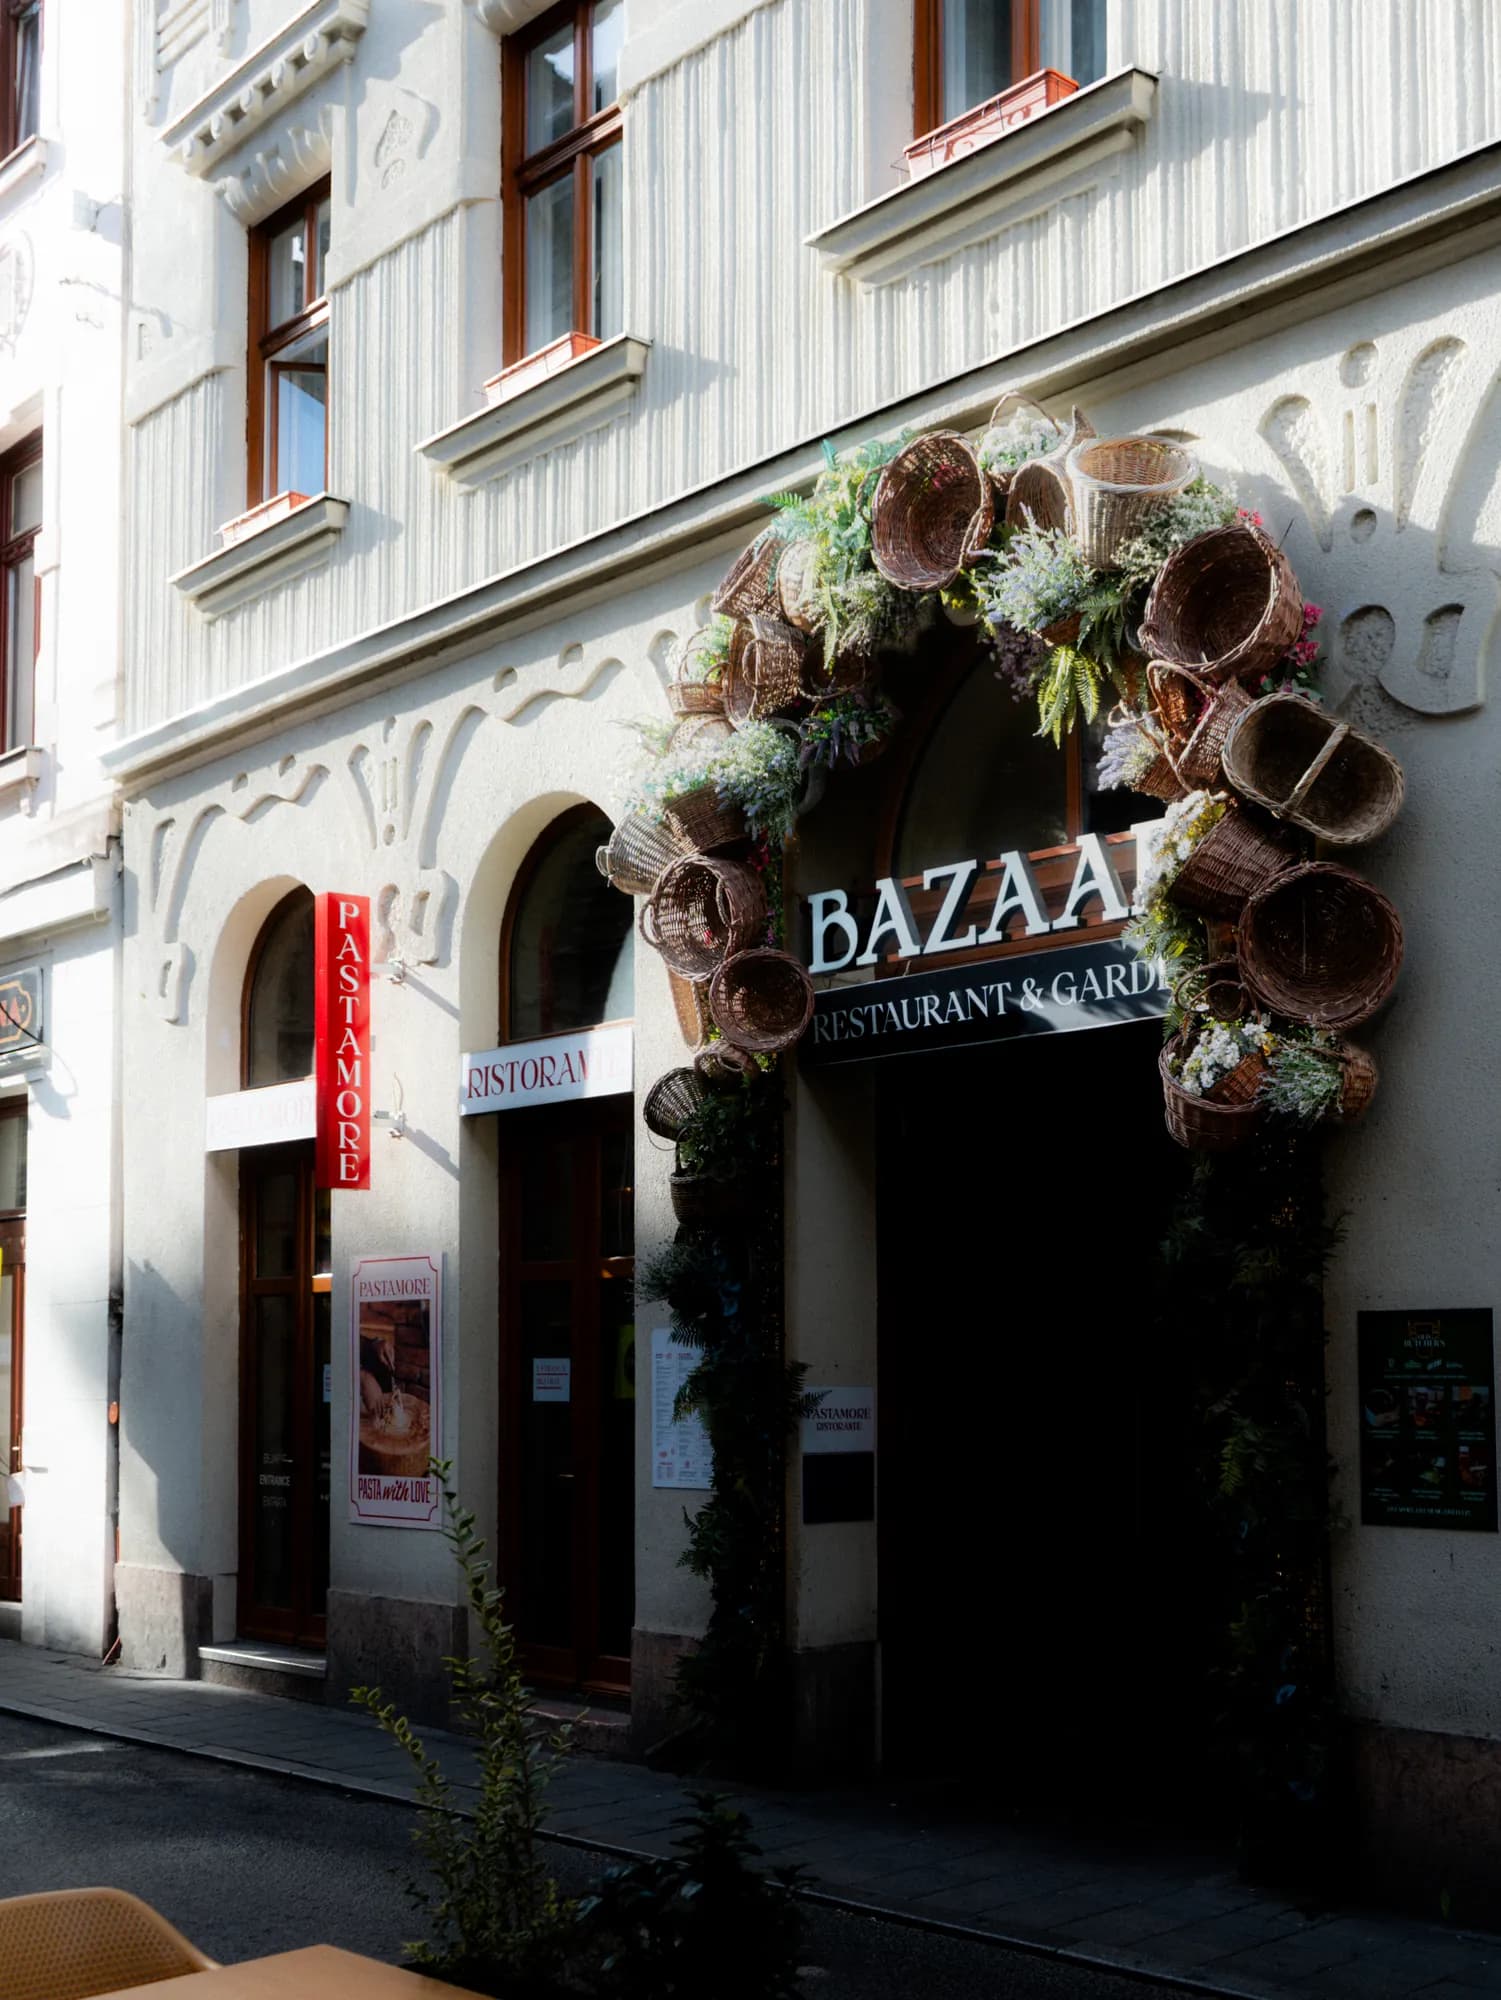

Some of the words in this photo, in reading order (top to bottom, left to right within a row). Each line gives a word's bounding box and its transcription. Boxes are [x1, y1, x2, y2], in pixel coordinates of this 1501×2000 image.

[813, 982, 1014, 1044] RESTAURANT
[1019, 976, 1044, 1012] &
[336, 901, 362, 1181] PASTAMORE
[467, 1049, 618, 1099] RISTORAN
[359, 1278, 431, 1297] PASTAMORE
[806, 1407, 872, 1420] PASTAMORE
[358, 1478, 382, 1500] PASTA
[383, 1481, 410, 1501] with
[410, 1480, 431, 1503] LOVE
